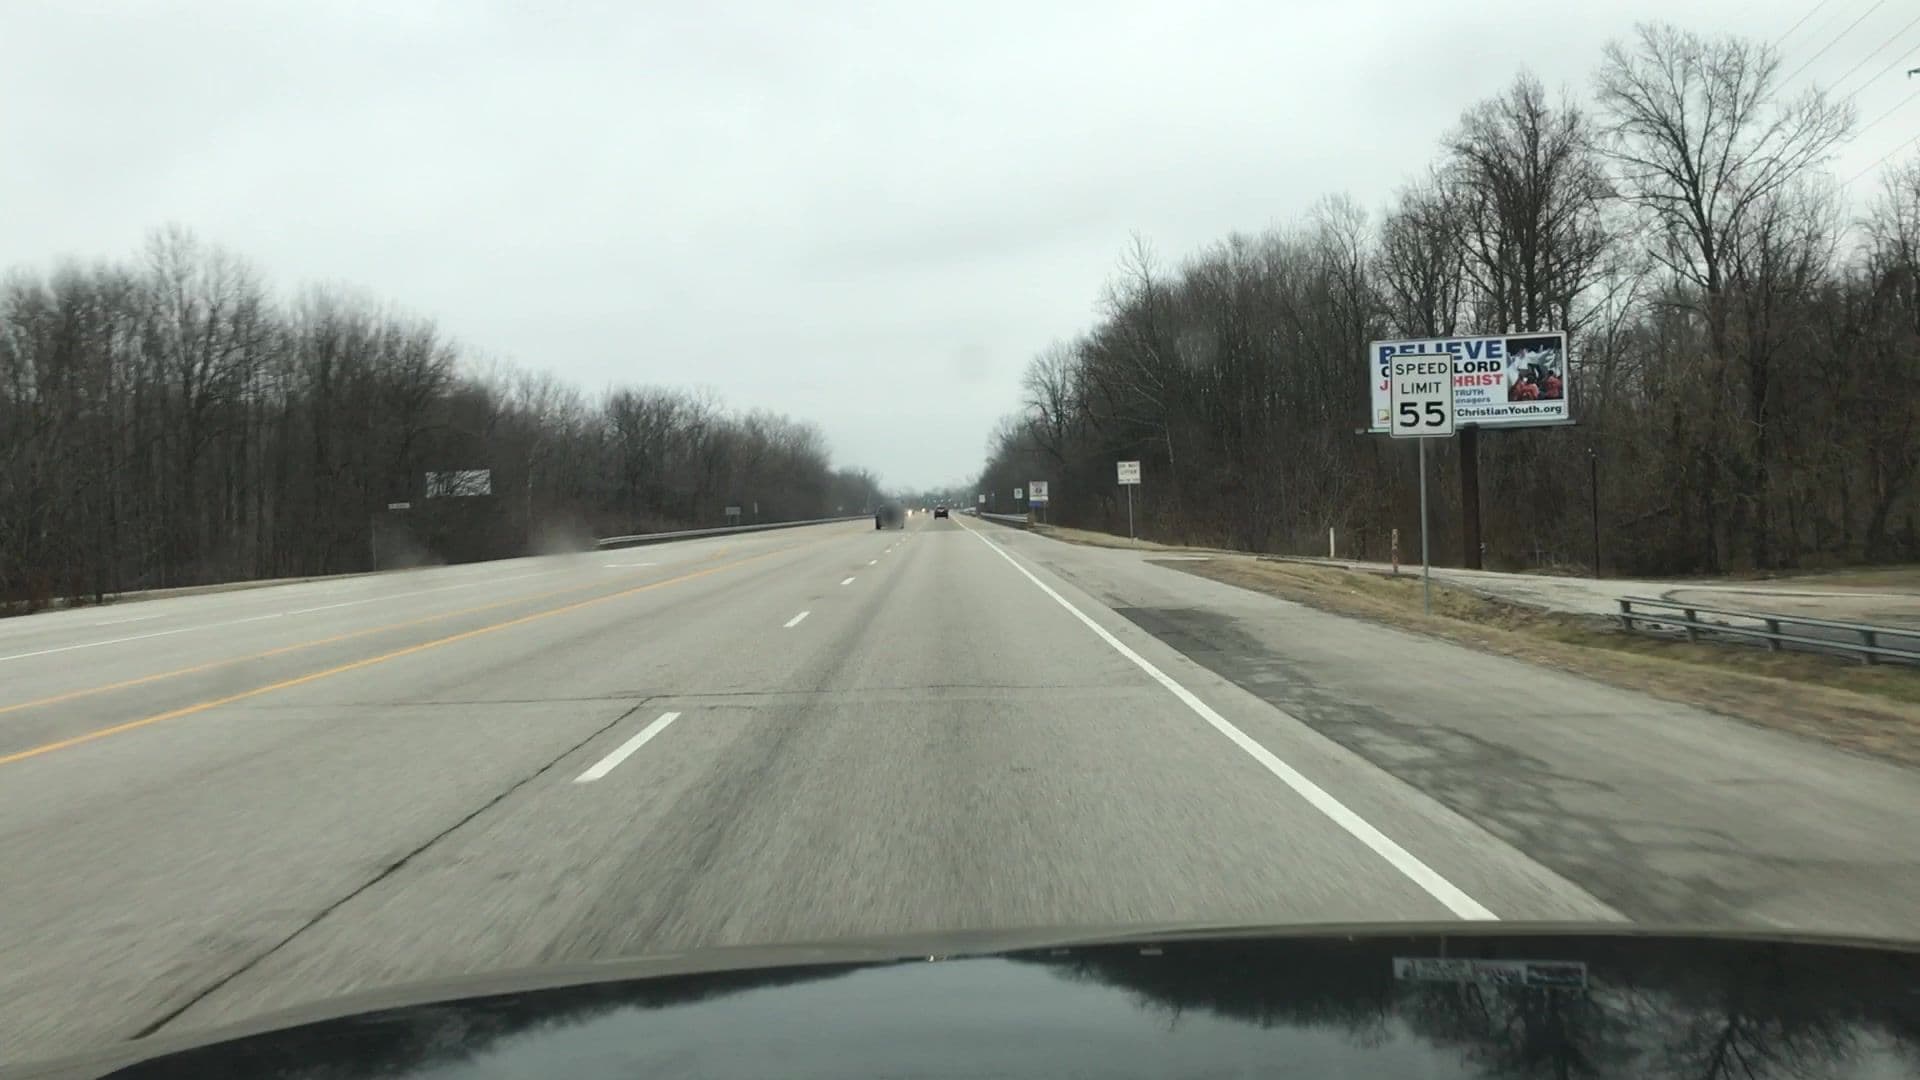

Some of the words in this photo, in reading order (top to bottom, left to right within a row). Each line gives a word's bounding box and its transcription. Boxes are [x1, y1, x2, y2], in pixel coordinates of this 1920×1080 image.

[1395, 362, 1448, 375] SPEED
[1454, 361, 1501, 373] LORD
[1453, 374, 1504, 387] HRIST
[1401, 382, 1442, 394] LIMIT
[1400, 401, 1446, 428] 55
[1454, 405, 1562, 417] ChristianYouth.org
